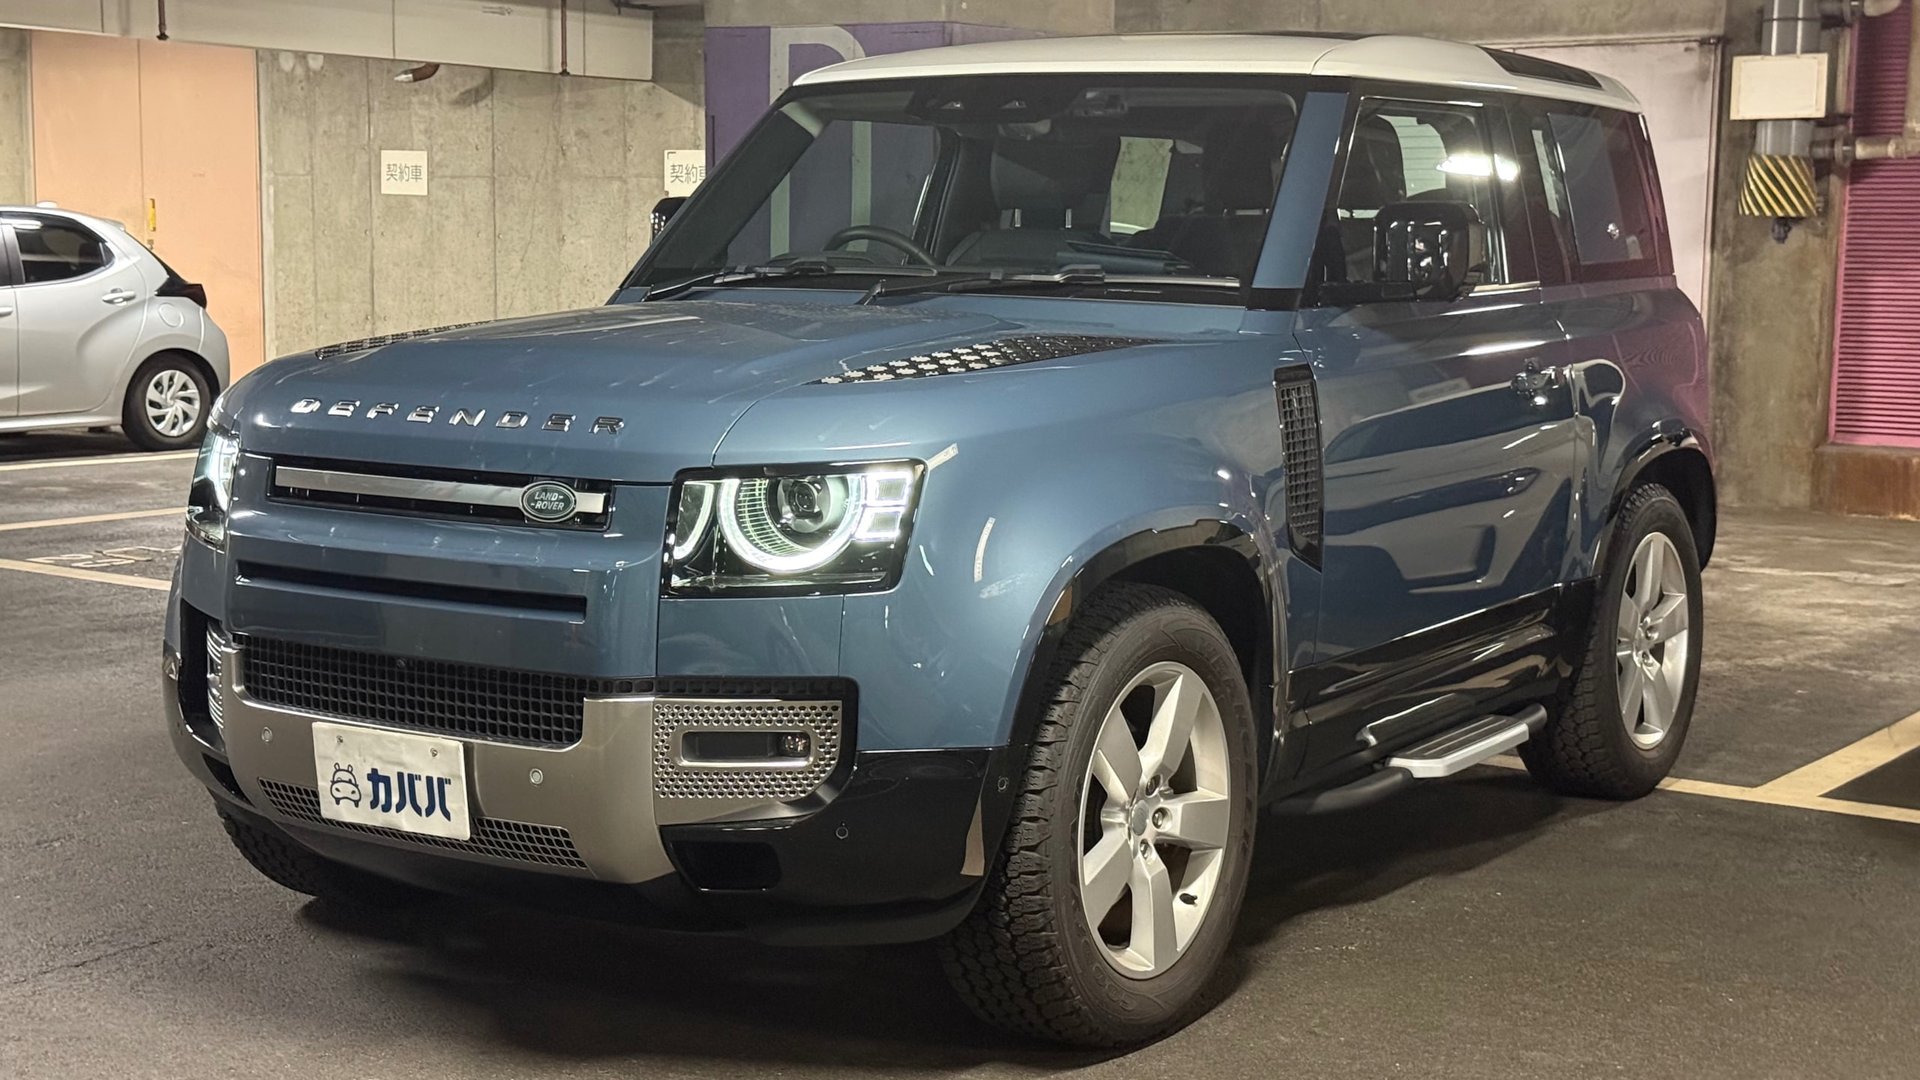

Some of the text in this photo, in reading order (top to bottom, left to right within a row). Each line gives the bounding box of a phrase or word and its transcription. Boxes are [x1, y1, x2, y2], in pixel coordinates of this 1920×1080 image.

[386, 163, 423, 183] 契約車
[290, 397, 626, 435] DEFENDER
[366, 767, 452, 822] カババ
